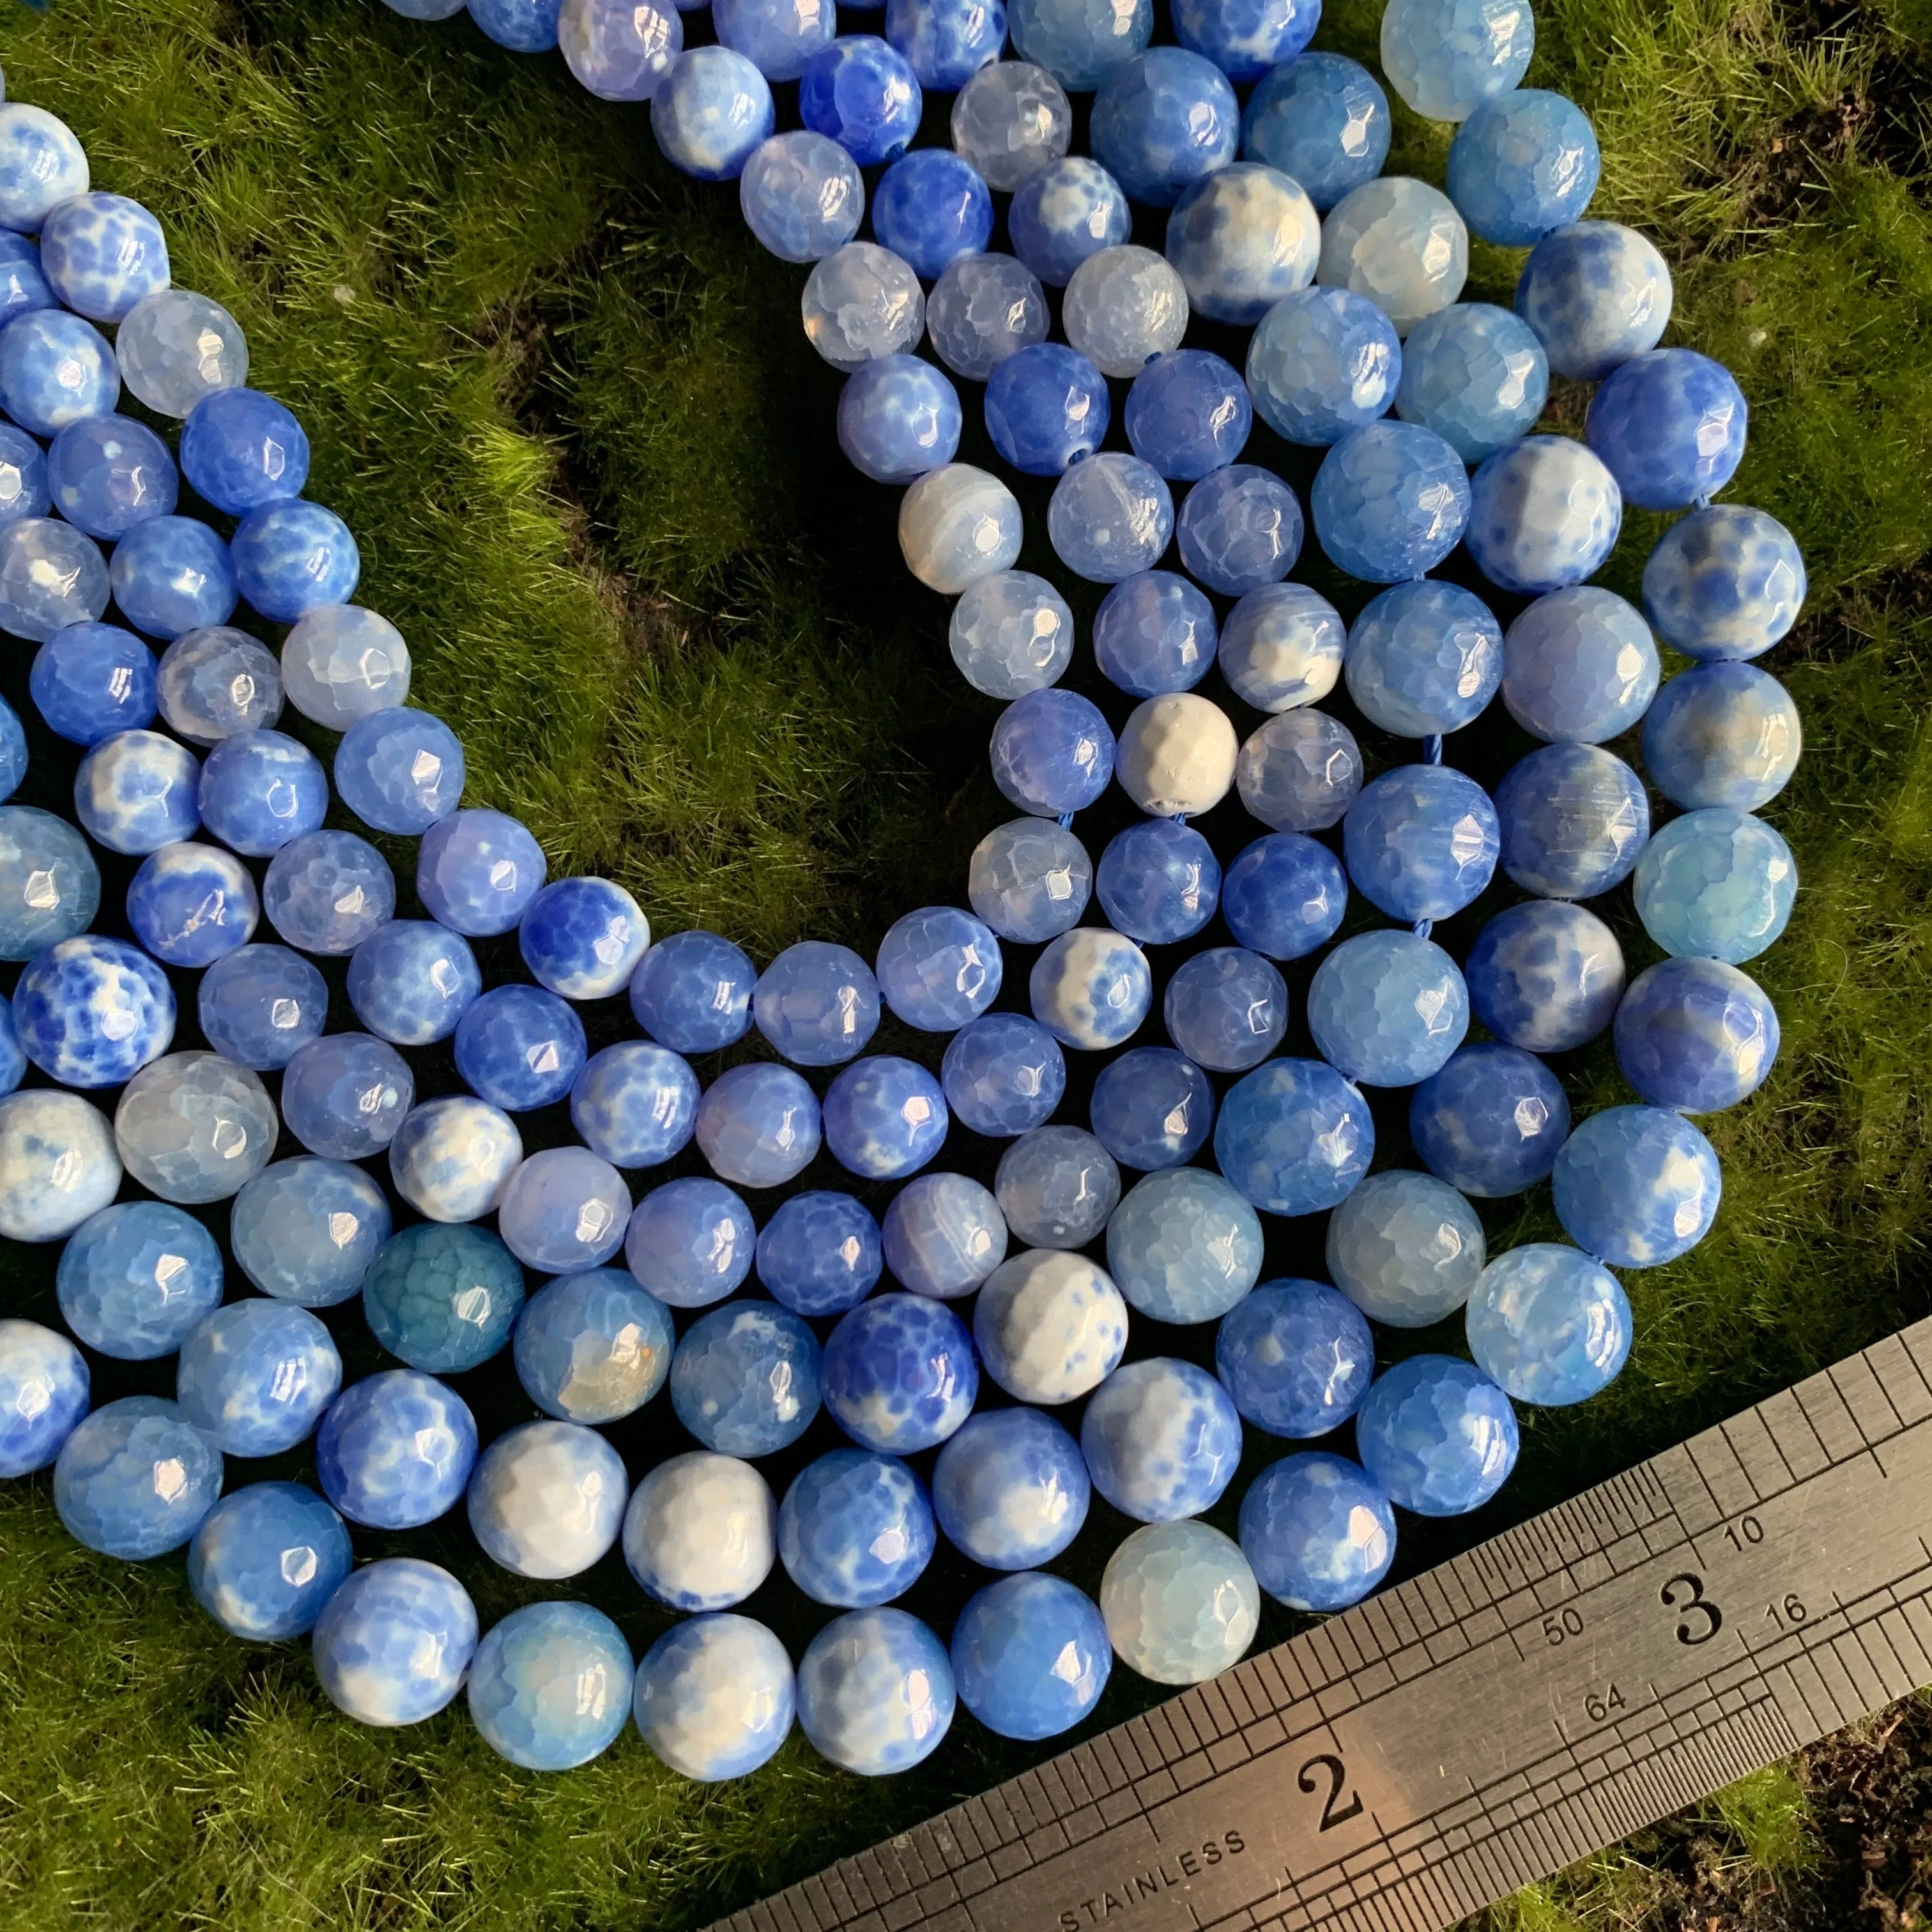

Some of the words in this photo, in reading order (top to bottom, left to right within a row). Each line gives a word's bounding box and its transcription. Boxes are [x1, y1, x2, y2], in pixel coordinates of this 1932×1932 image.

[1724, 1515, 1764, 1551] 10
[1542, 1607, 1584, 1646] 50
[1660, 1572, 1722, 1645] 3
[1765, 1593, 1807, 1630] 16
[1583, 1683, 1626, 1722] 64
[1298, 1754, 1365, 1832] 2
[1058, 1830, 1246, 1932] STAINLESS
